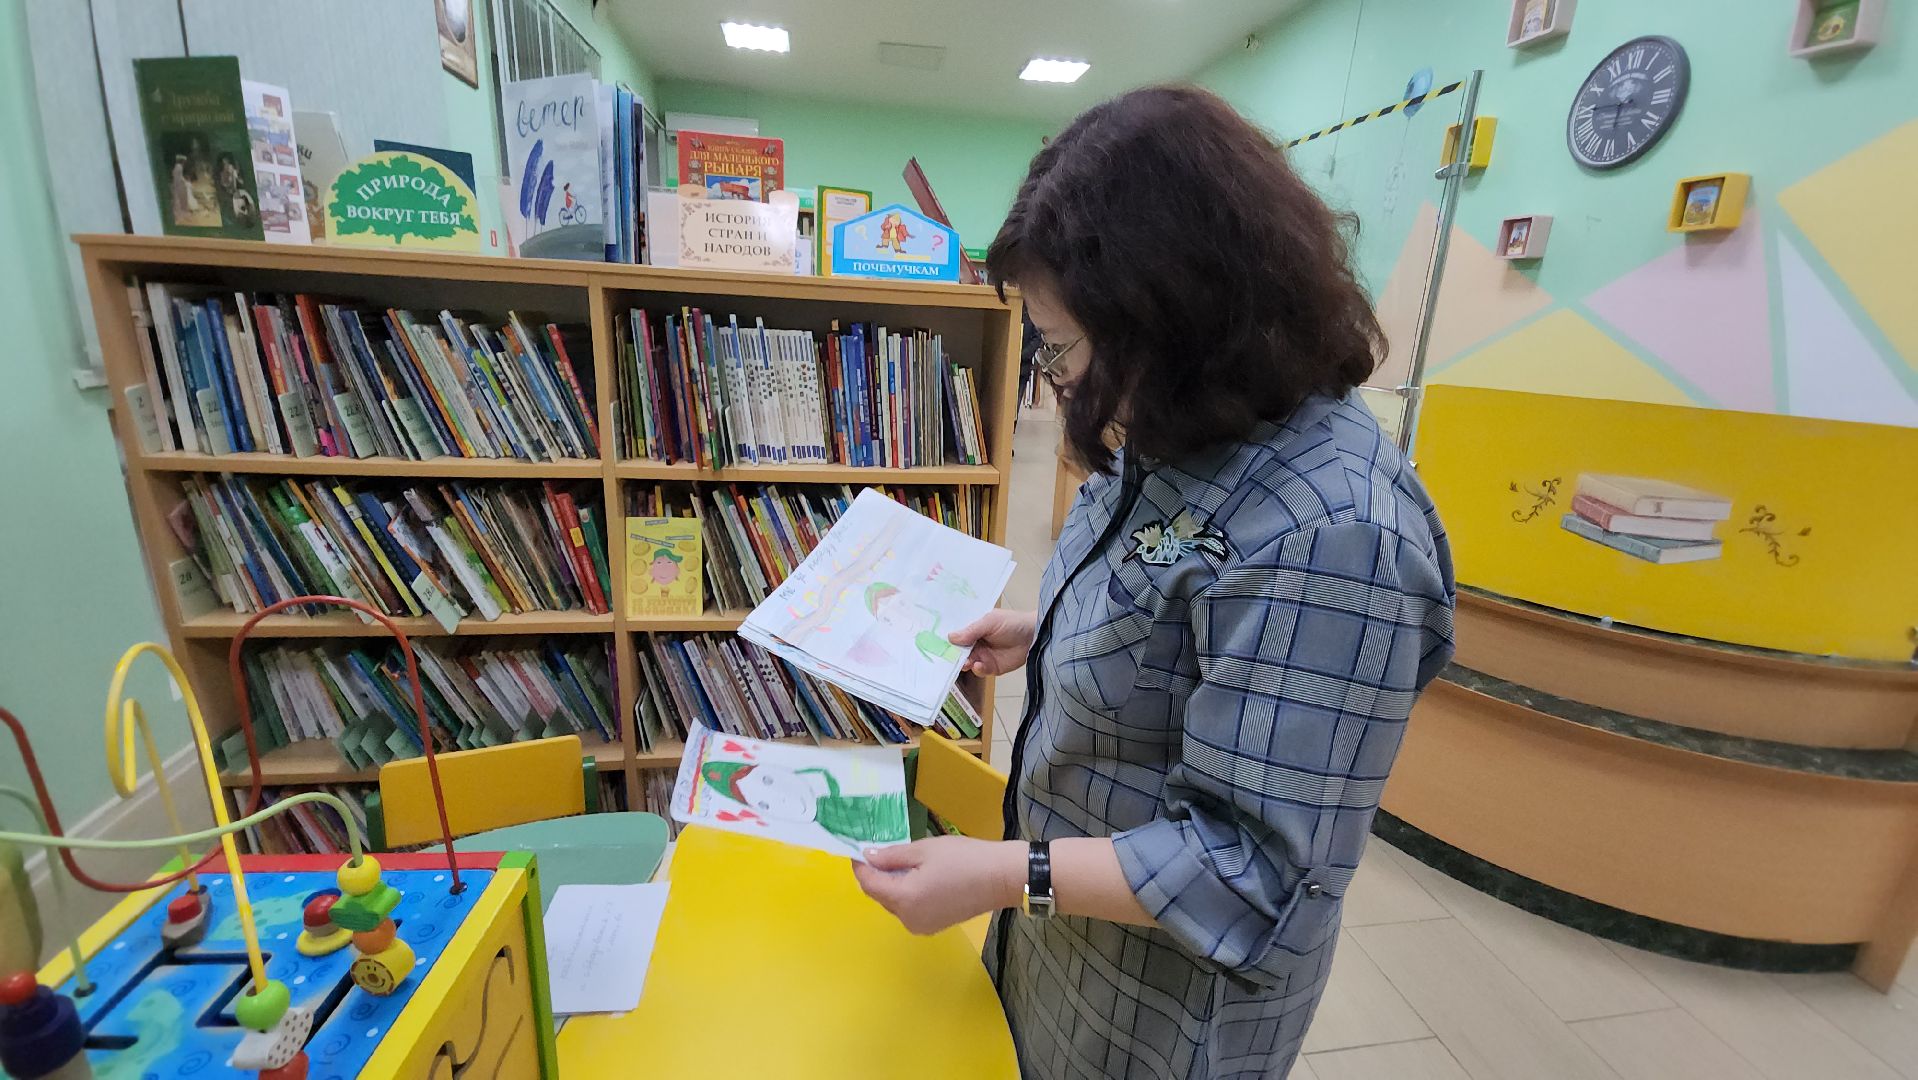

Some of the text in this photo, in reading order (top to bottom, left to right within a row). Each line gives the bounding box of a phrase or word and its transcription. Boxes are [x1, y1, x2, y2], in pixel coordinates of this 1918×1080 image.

[690, 150, 780, 166] ДЛЯ МАЛЕНЬКОГО
[704, 161, 761, 177] РЫЦАРЯ
[356, 174, 450, 208] ПРИРОДА
[346, 204, 461, 226] ВОКРУГ ТЕБЯ
[708, 228, 754, 241] СТРАН
[704, 242, 771, 257] НАРОДОВ
[853, 261, 939, 276] ПОЧЕМУЧКАМ
